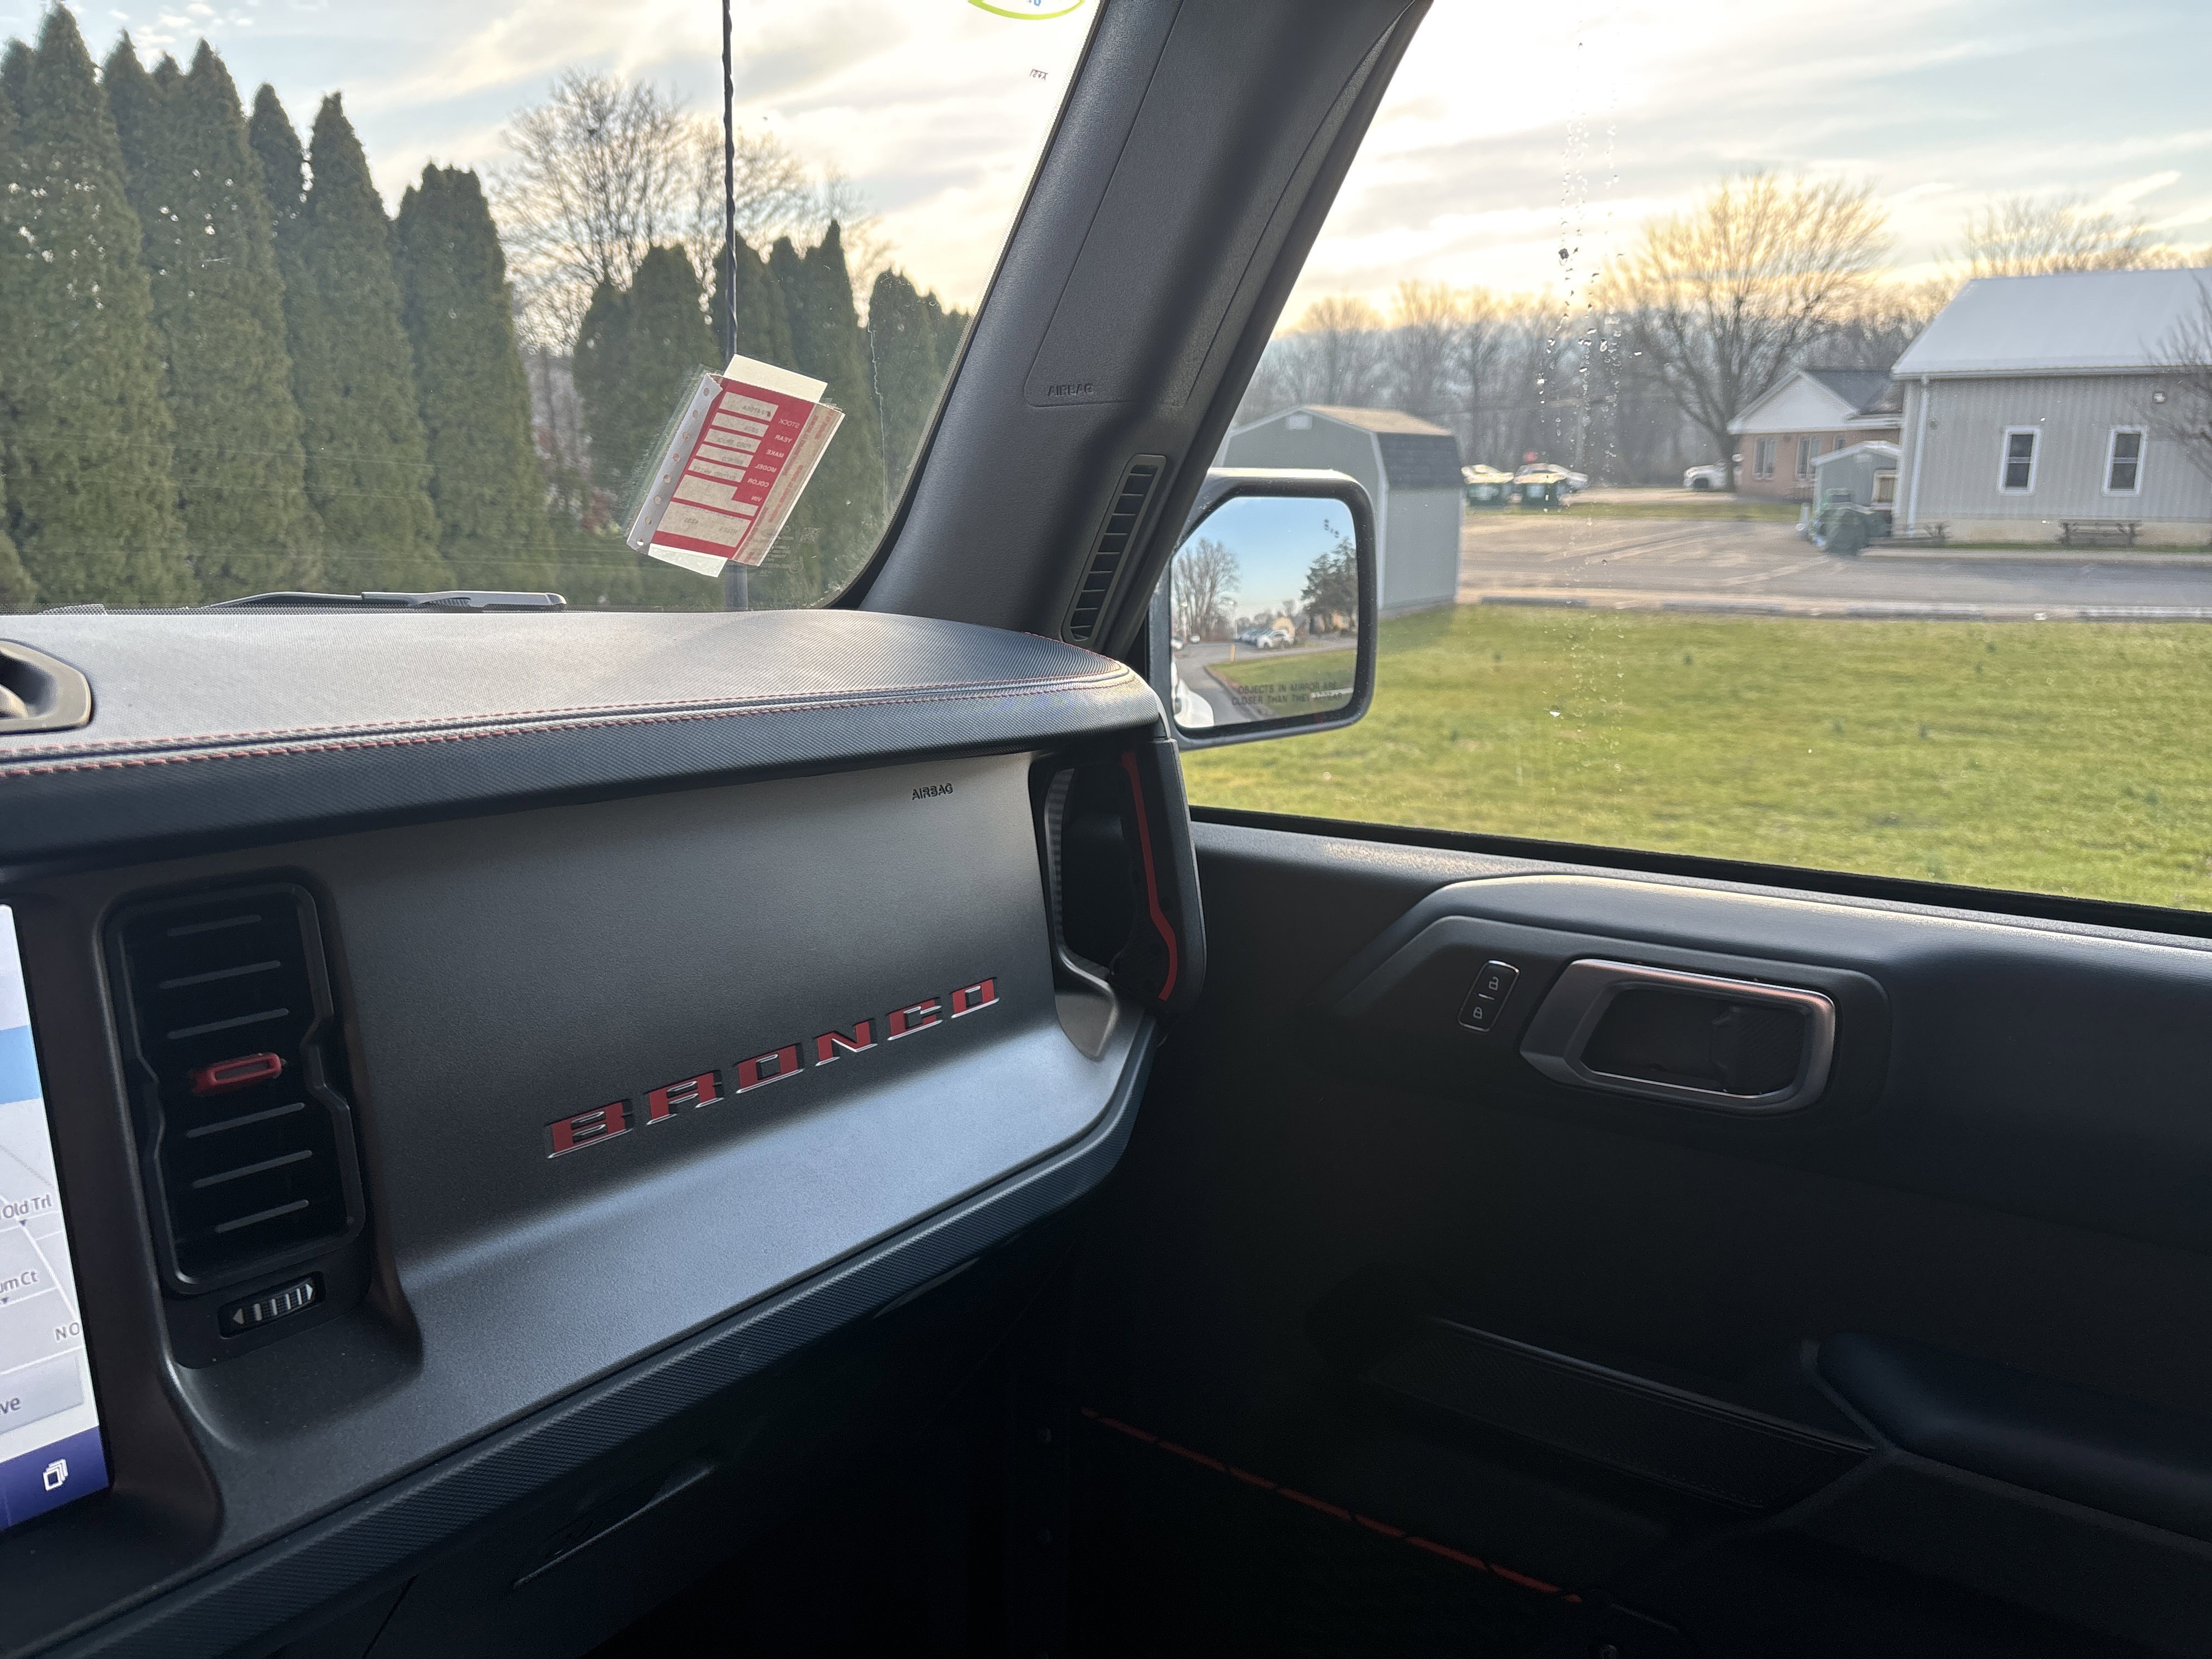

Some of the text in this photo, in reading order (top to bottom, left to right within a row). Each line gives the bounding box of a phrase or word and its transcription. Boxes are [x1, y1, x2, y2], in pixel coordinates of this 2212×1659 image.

[1047, 383, 1094, 397] AIRBAG
[1238, 685, 1274, 694] OBJECTS
[1279, 684, 1287, 692] IN
[1290, 682, 1320, 692] MIRROR
[1232, 696, 1263, 706] CLOSER
[1267, 695, 1288, 703] THAN
[912, 783, 953, 800] AIRBAG
[546, 977, 1000, 1159] BRONCO
[2, 1194, 52, 1219] Old Trl
[20, 1271, 38, 1285] Ct
